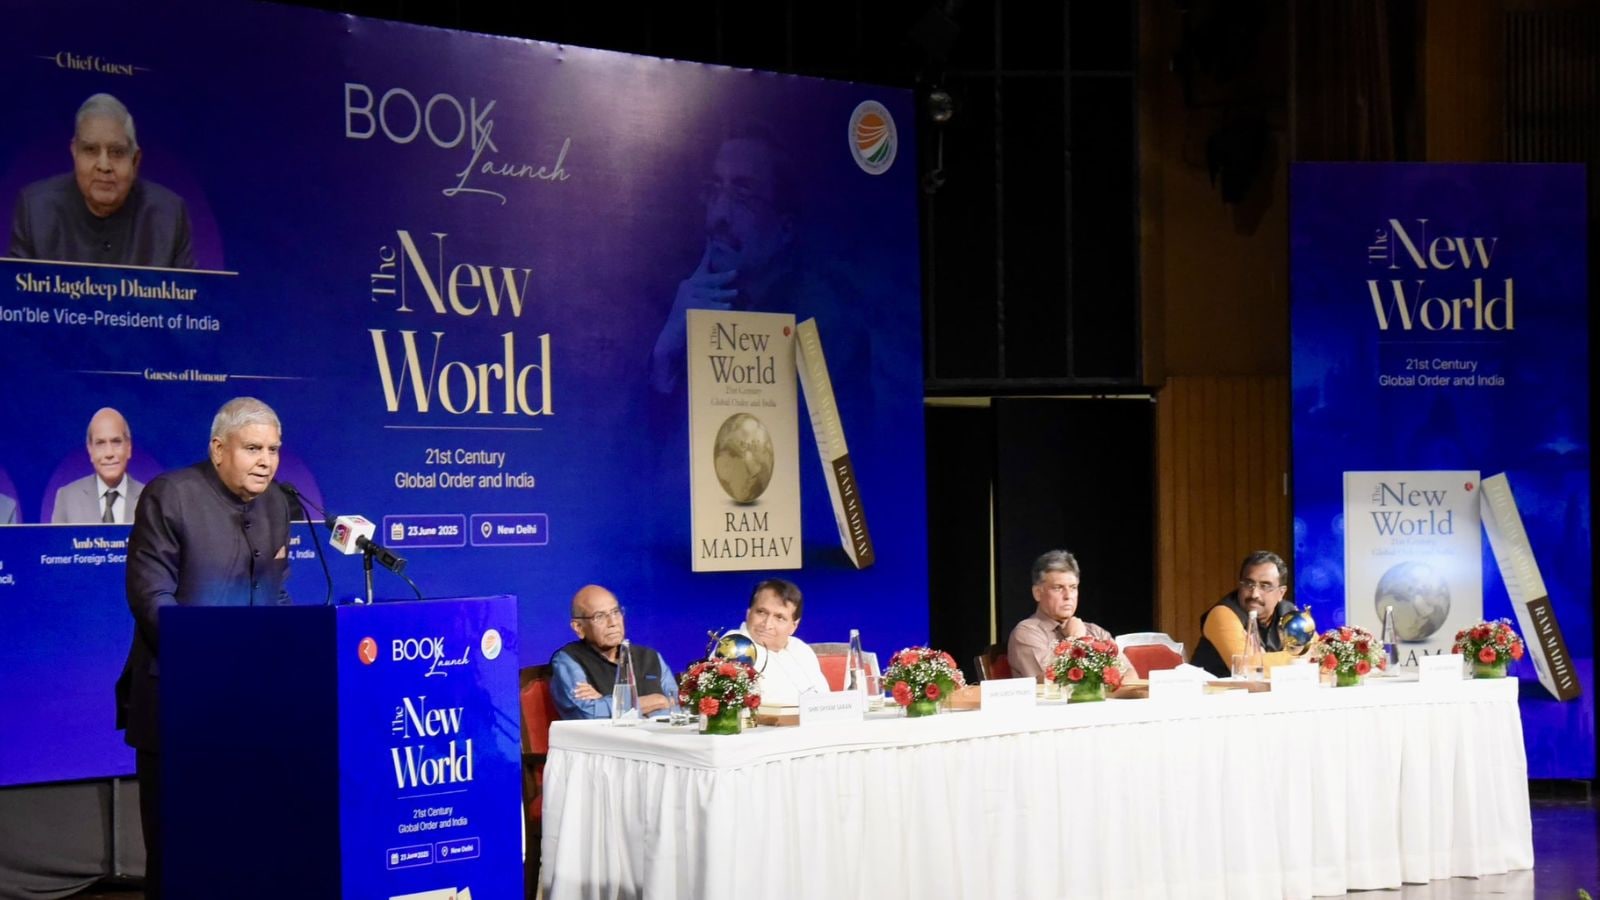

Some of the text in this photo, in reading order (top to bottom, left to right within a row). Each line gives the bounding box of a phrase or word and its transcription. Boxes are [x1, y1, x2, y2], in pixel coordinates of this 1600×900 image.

[56, 51, 133, 76] Chief Guest
[345, 82, 498, 152] BOOK
[442, 119, 571, 206] Launch
[1368, 218, 1499, 270] The New
[371, 229, 533, 318] The New
[15, 272, 197, 301] Shri Jagdeep Dhankhar
[1366, 277, 1515, 331] World
[53, 308, 164, 328] Vice-President
[167, 314, 182, 329] of
[186, 315, 220, 331] India
[716, 322, 770, 352] New
[144, 368, 228, 382] Guests of Honour
[368, 329, 555, 416] World
[708, 355, 776, 384] World
[1406, 358, 1478, 373] 21st Century
[1379, 374, 1505, 387] Global Order and India
[425, 449, 505, 468] 21st Century
[394, 472, 535, 489] Global Order and India
[1379, 482, 1448, 507] New
[724, 511, 769, 532] RAM
[838, 466, 869, 556] RAM MADHAV
[1370, 509, 1454, 536] World
[407, 525, 458, 536] 23 June 2025
[497, 524, 537, 535] New Delhi
[73, 537, 92, 549] Amb
[94, 537, 125, 552] Shyam
[296, 550, 315, 558] India
[701, 536, 793, 559] MADHAV
[40, 554, 72, 564] Former
[74, 554, 106, 566] Foreign
[392, 636, 444, 661] BOOK
[1535, 606, 1573, 689] RAM MADHAV
[424, 644, 470, 678] Launch
[392, 696, 464, 738] The New
[390, 738, 474, 789] World
[413, 806, 454, 818] 21st Century
[398, 816, 468, 834] Global Order and India
[450, 844, 474, 854] New Delhi
